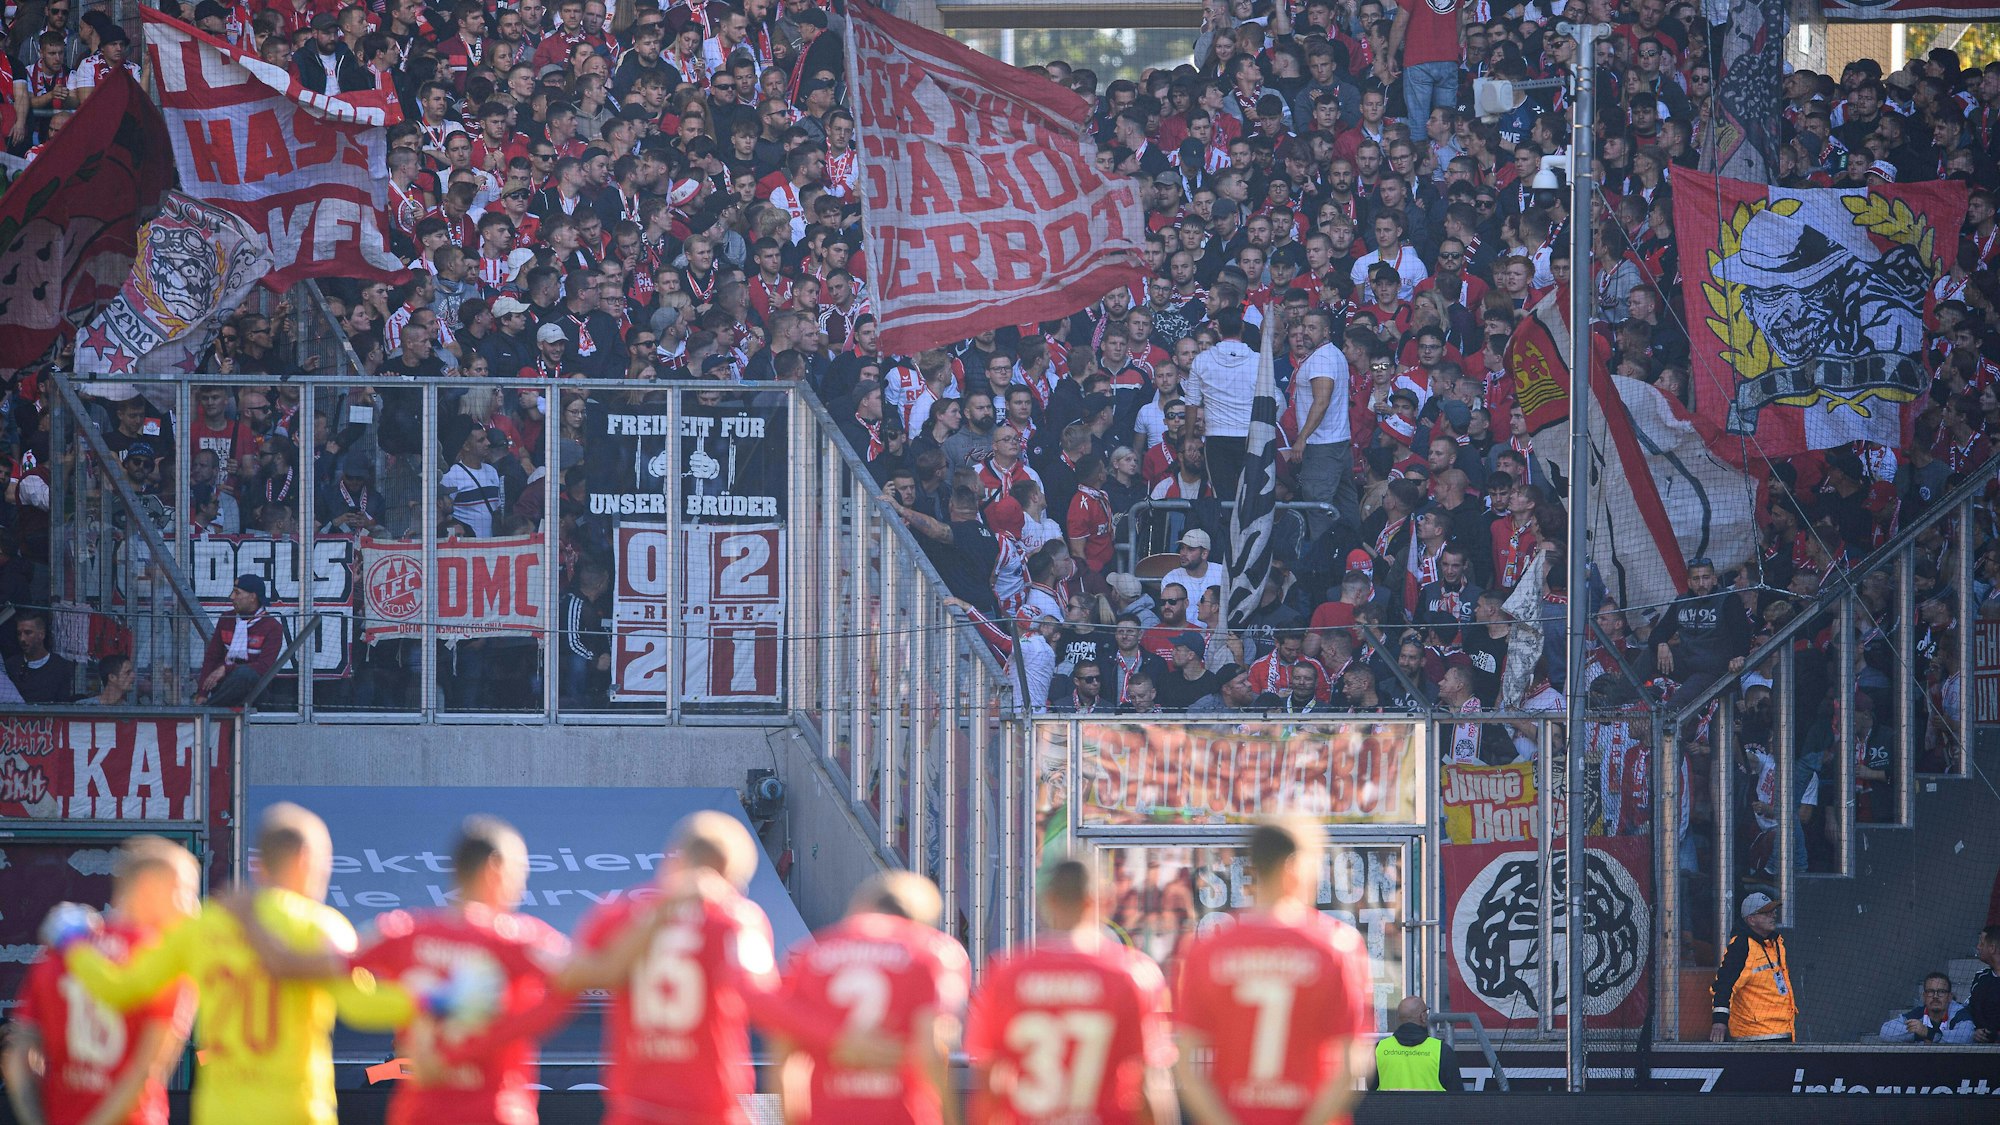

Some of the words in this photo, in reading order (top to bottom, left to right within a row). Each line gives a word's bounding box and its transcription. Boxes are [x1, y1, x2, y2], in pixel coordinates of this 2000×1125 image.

[267, 197, 404, 272] VFL
[870, 185, 1135, 301] VERBOT
[720, 412, 766, 438] FÜR
[590, 493, 669, 515] UNSER
[687, 490, 778, 517] BRÜDER
[437, 553, 540, 618] DMC
[1699, 608, 1716, 622] 96
[57, 721, 221, 820] KAT
[1444, 768, 1522, 804] Junge
[1230, 975, 1297, 1083] 7
[1383, 1048, 1431, 1057] Ordnungsdienst
[1003, 1008, 1114, 1118] 37
